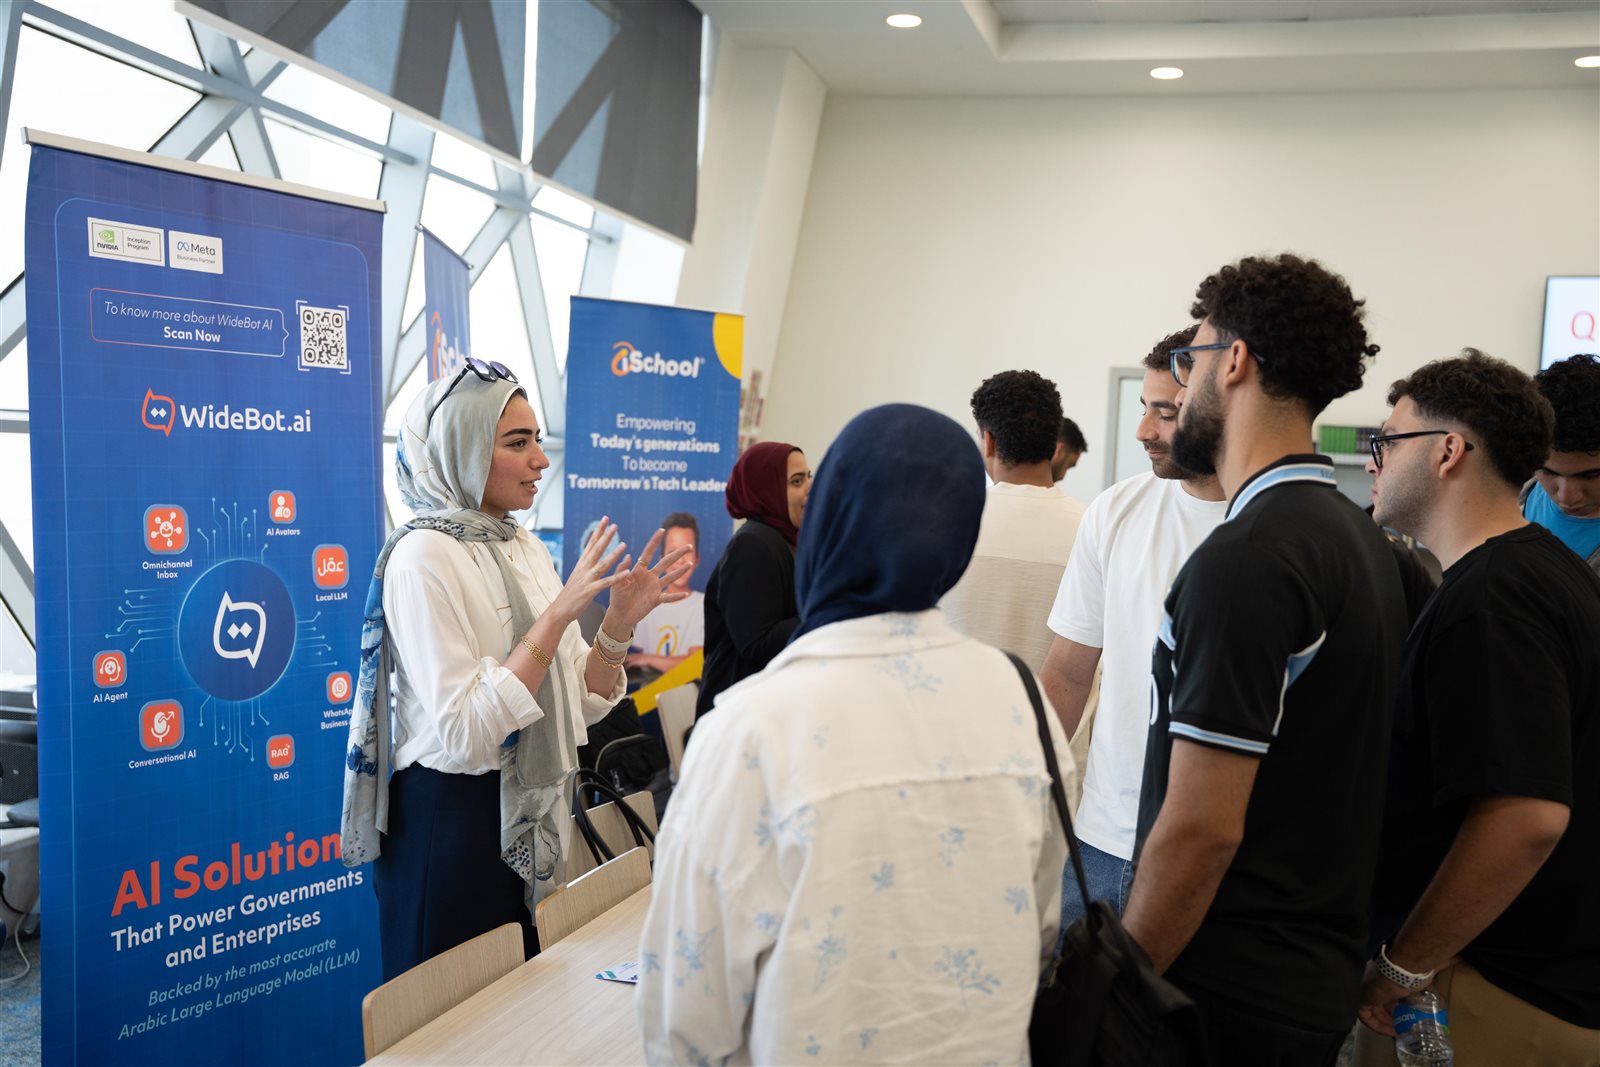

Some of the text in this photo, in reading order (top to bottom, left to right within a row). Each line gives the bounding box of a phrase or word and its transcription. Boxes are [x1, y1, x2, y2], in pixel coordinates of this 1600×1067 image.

[127, 236, 151, 245] Inception
[127, 243, 149, 251] Program
[191, 243, 216, 255] Meta
[177, 254, 198, 262] Business
[105, 302, 272, 331] To know more about WideBot AI
[163, 326, 221, 343] Scan Now
[612, 345, 701, 378] iSchool
[180, 404, 311, 432] WideBot.ai
[616, 413, 696, 435] Empowering
[590, 433, 720, 453] Today's generations
[622, 456, 688, 473] To become
[568, 474, 727, 492] Tomorrow's Tech Leader
[266, 528, 300, 536] AI Avatars
[142, 559, 193, 570] Omnichannel
[157, 571, 178, 579] Inbox
[315, 592, 348, 602] Local LLM
[93, 692, 128, 703] AI Agent
[323, 708, 353, 719] WhatsAp
[320, 720, 348, 730] Business
[128, 750, 196, 769] Conversational AI
[271, 748, 289, 758] RAG
[273, 772, 289, 781] RAG
[111, 832, 342, 917] AI Solution
[111, 870, 364, 952] That Power Governments
[165, 910, 321, 968] and Enterprises
[148, 938, 336, 1006] Backed by the most accurate
[118, 948, 361, 1040] Arabic Large Language Model (LLM)
